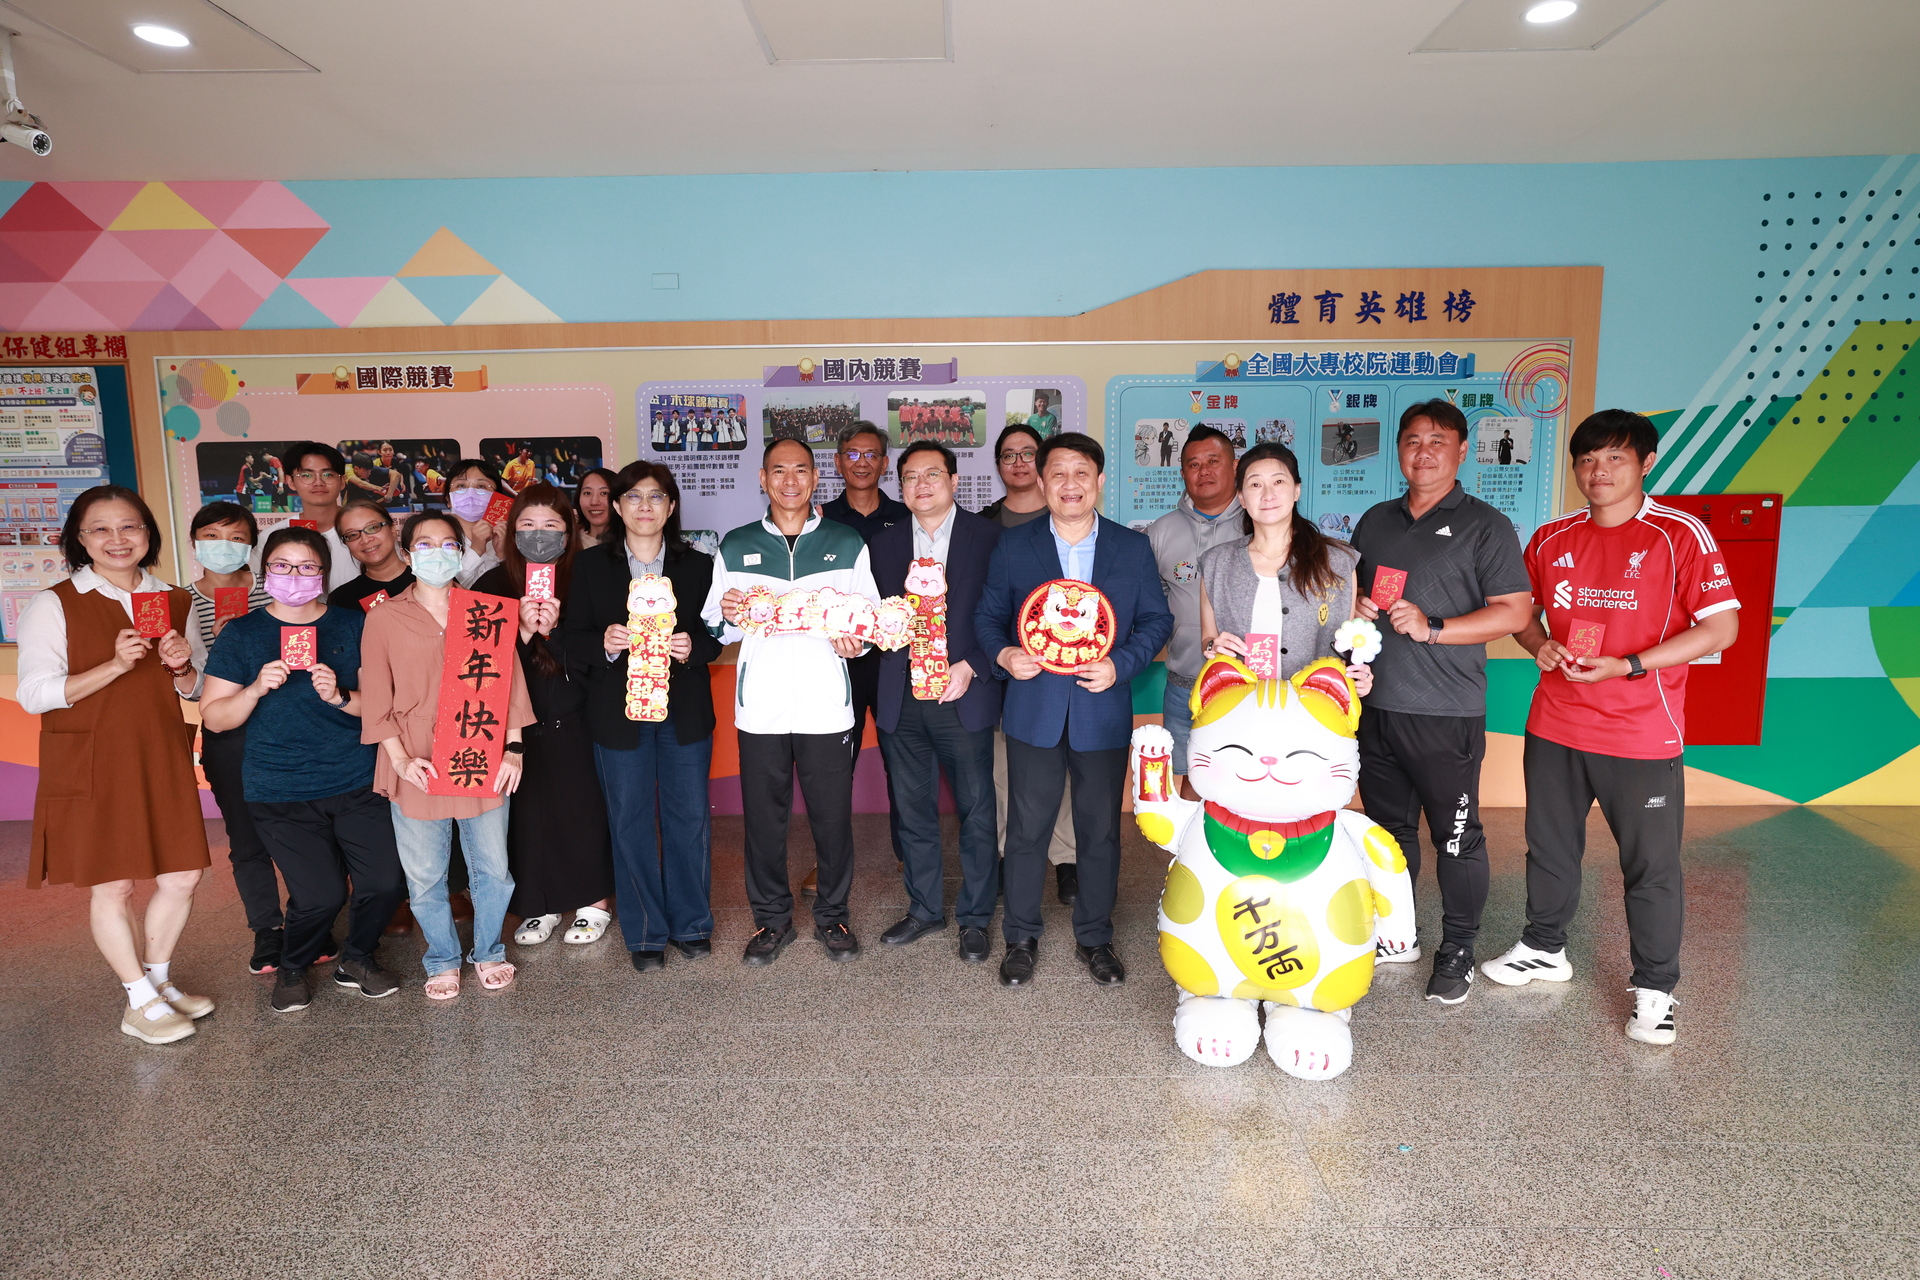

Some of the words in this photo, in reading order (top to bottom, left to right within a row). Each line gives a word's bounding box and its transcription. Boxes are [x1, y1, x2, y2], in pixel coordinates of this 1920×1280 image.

[1268, 289, 1476, 324] 體育英雄榜
[0, 334, 128, 359] 保健組專欄
[822, 357, 922, 382] 國內競賽
[1246, 350, 1460, 376] 全國大專校院運動會
[356, 365, 454, 389] 國際競賽
[1206, 395, 1239, 409] 金牌
[1346, 392, 1378, 408] 銀牌
[1462, 393, 1494, 408] 銅牌
[1576, 598, 1638, 611] chartered
[1577, 586, 1635, 600] standard
[777, 604, 875, 637] 五福門
[913, 616, 946, 698] 萬事如意
[631, 633, 669, 718] 恭喜發財
[448, 599, 508, 788] 新年快樂
[1447, 808, 1469, 857] ELME
